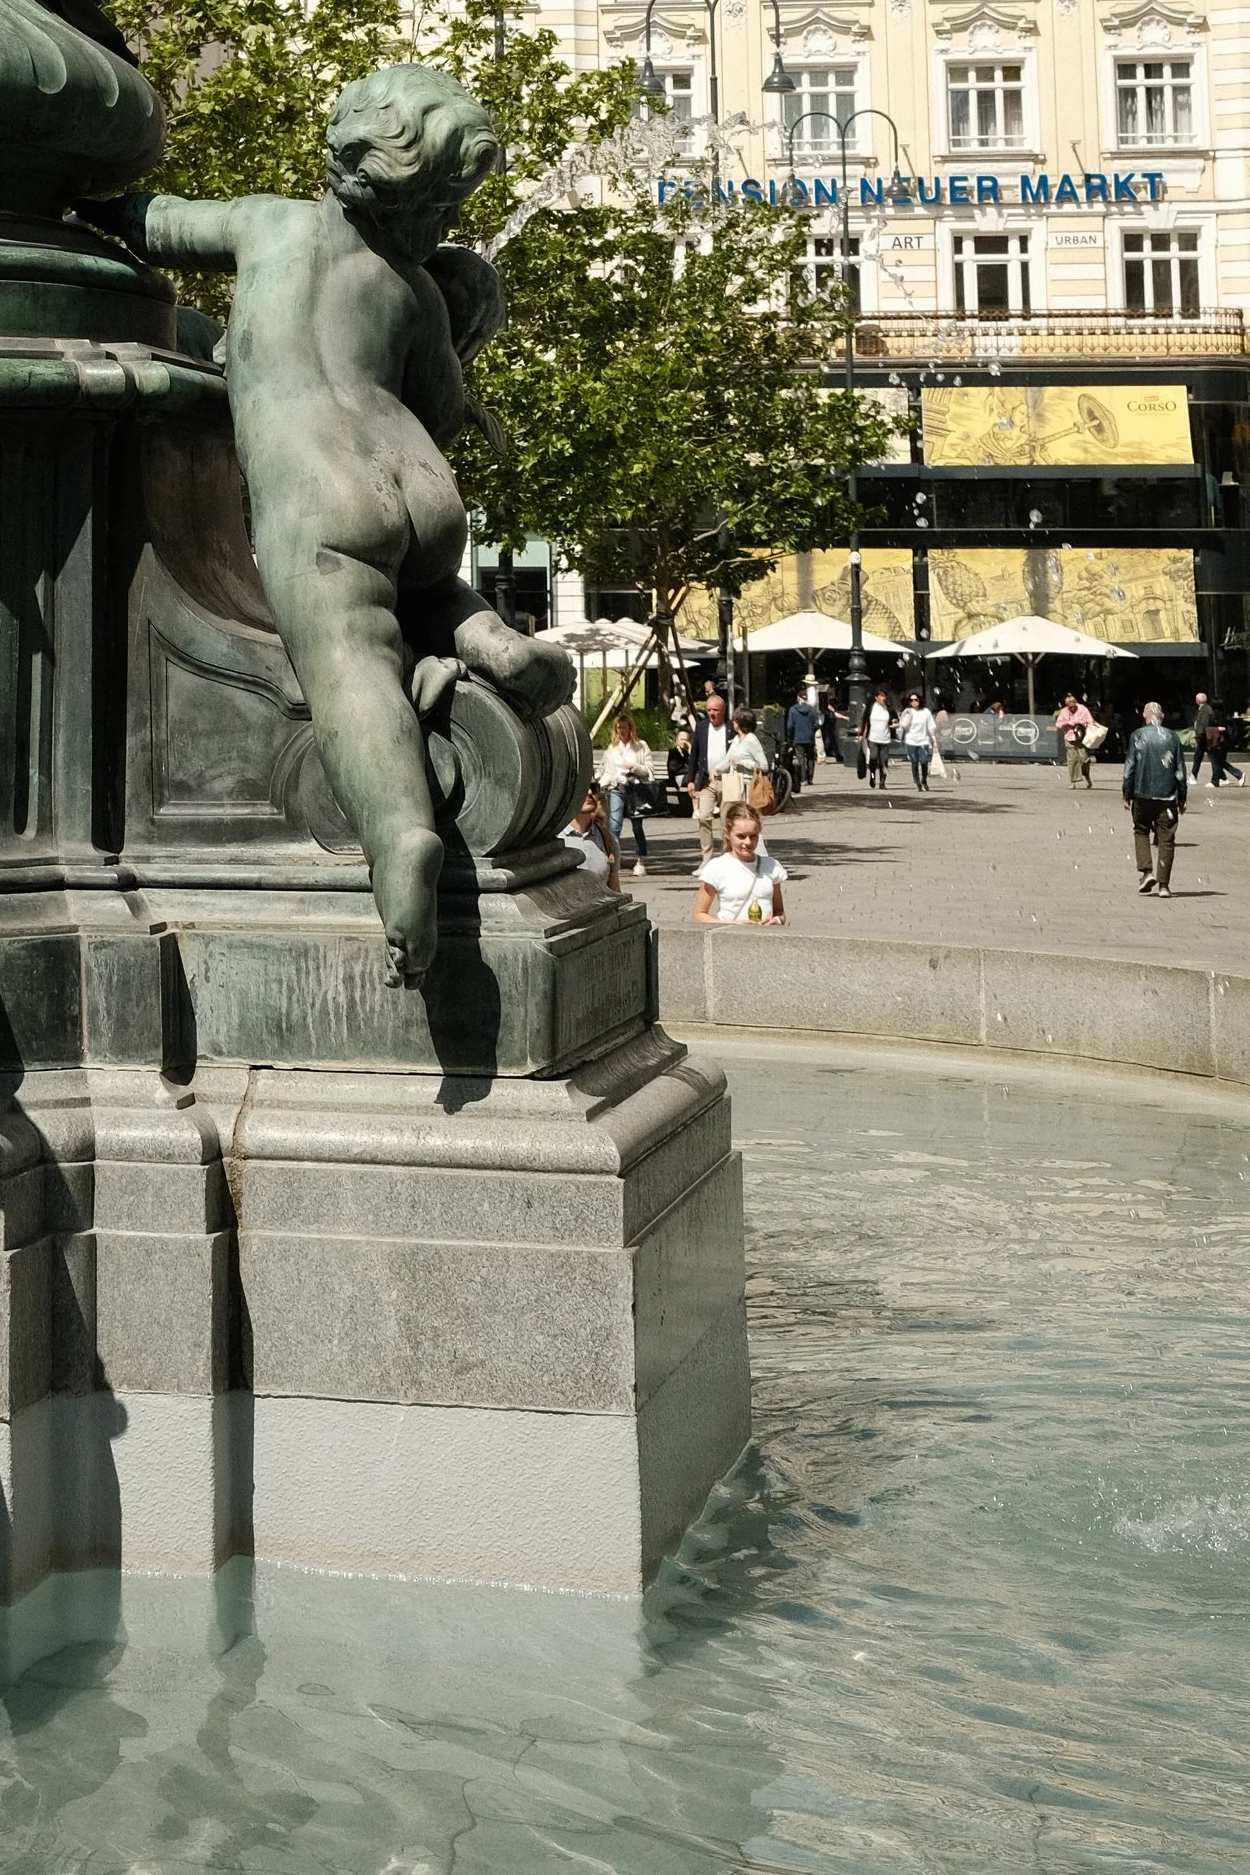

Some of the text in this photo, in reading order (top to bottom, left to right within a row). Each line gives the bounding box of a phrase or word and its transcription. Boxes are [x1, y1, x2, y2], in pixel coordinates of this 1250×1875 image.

[1020, 172, 1163, 202] MARKT
[891, 236, 924, 249] ART
[1055, 235, 1097, 245] URBAN
